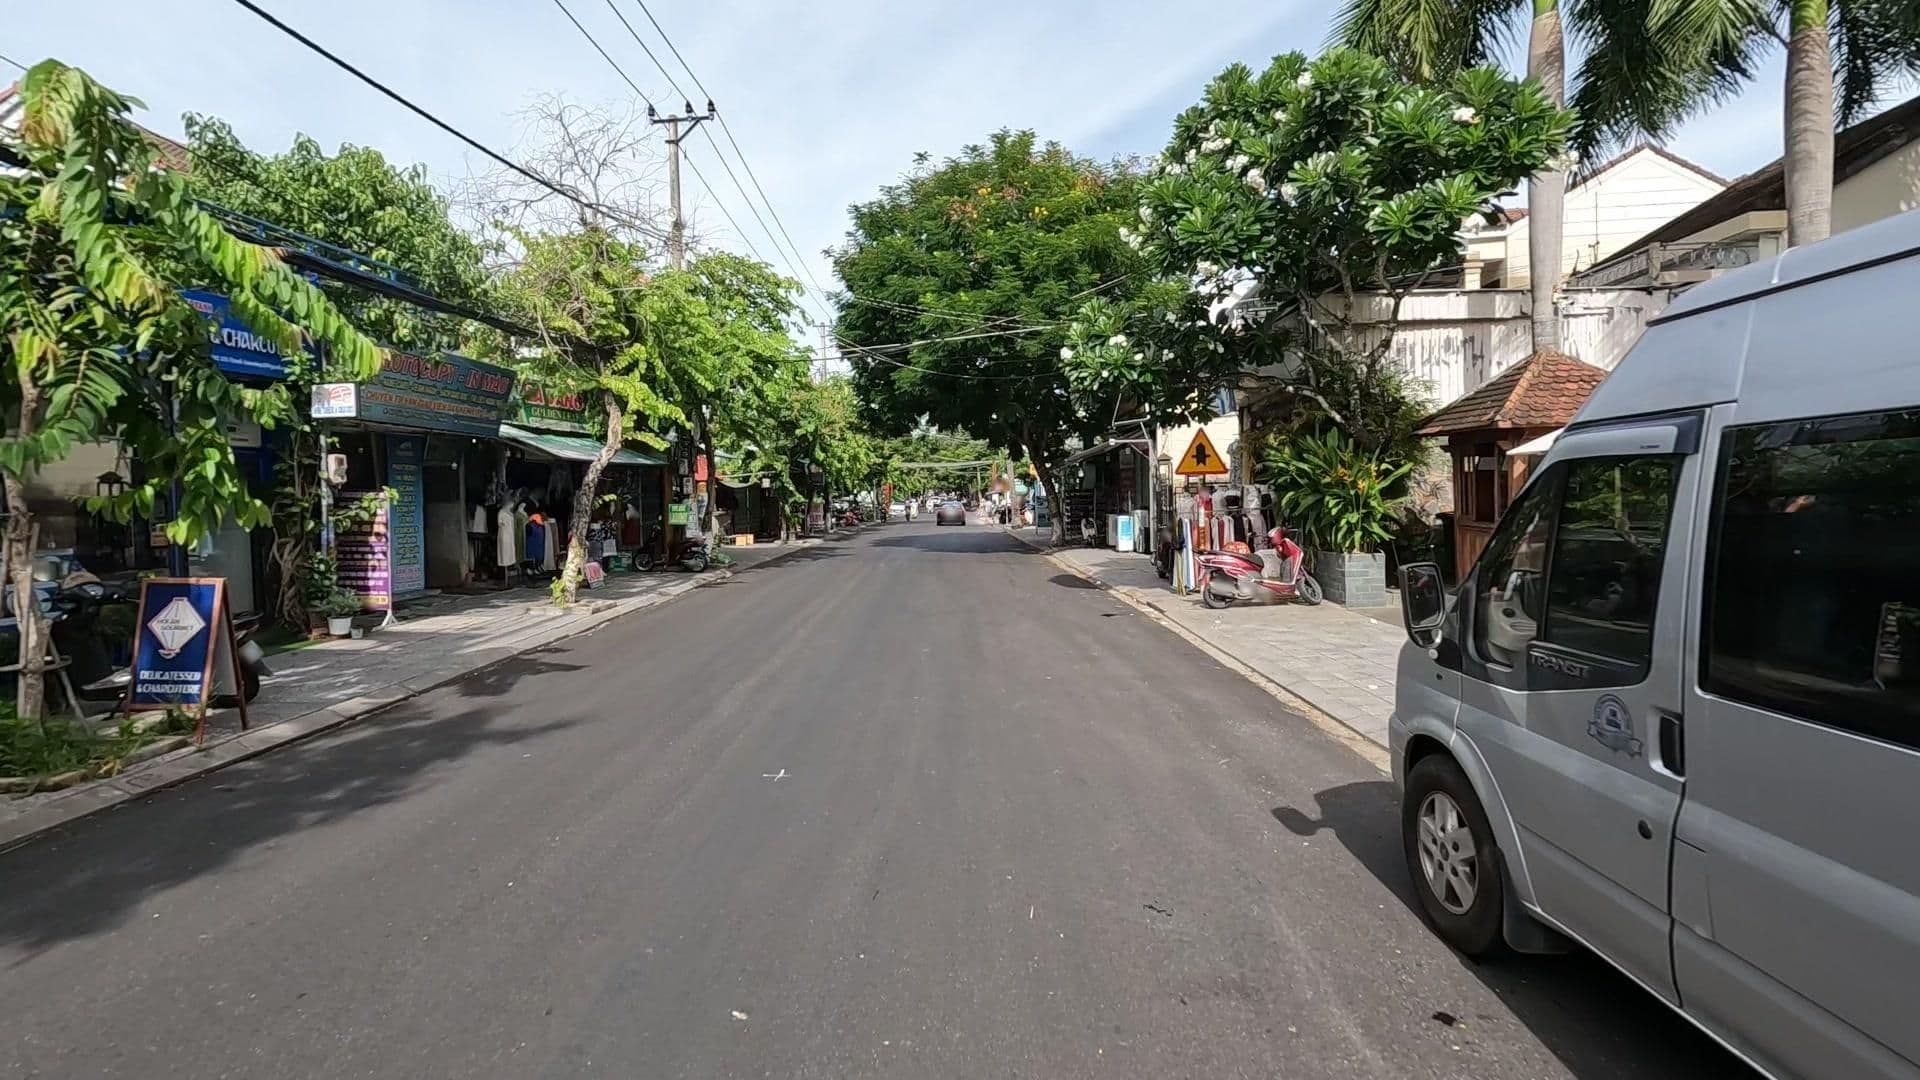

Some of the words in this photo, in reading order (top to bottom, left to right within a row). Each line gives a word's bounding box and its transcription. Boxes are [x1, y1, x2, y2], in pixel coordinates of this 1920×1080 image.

[531, 405, 561, 419] GOLDEN
[1529, 651, 1589, 679] TRANSIT
[140, 670, 201, 681] DELICATESSEN
